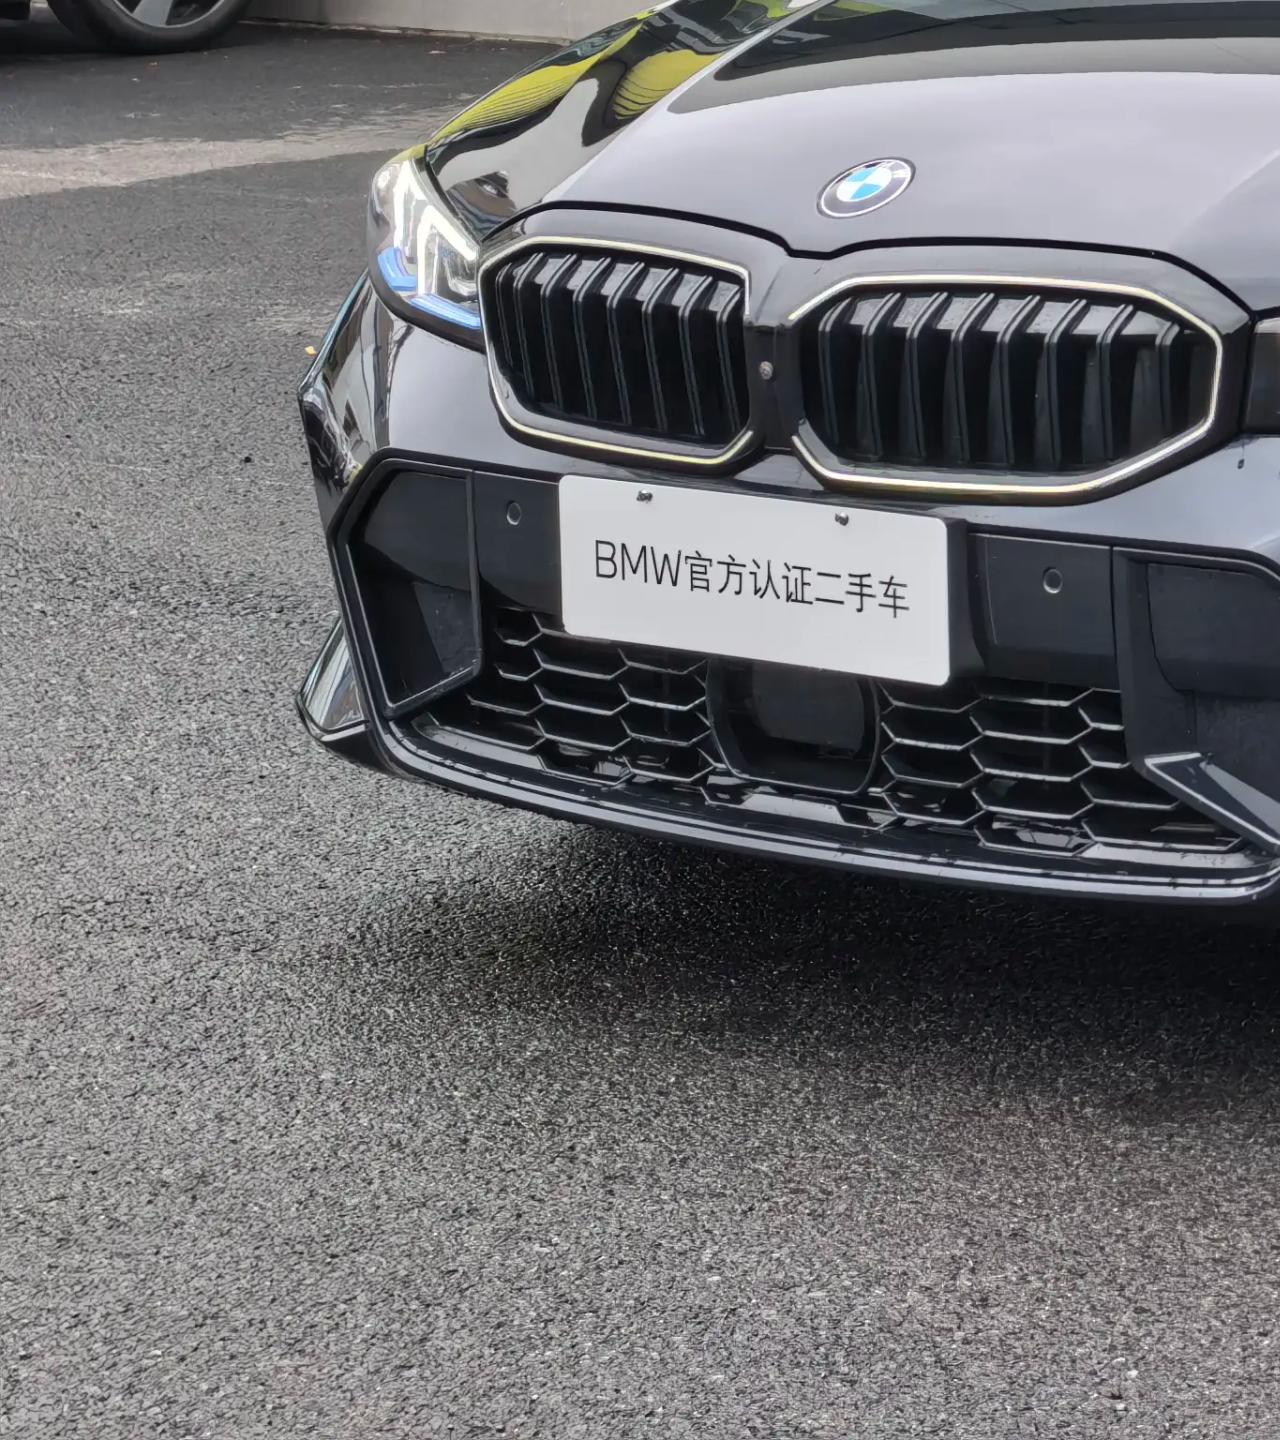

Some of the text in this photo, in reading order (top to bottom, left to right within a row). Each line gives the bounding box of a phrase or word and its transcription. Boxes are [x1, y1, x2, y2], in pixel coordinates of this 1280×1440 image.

[594, 539, 911, 619] BMW官方认证二手车
